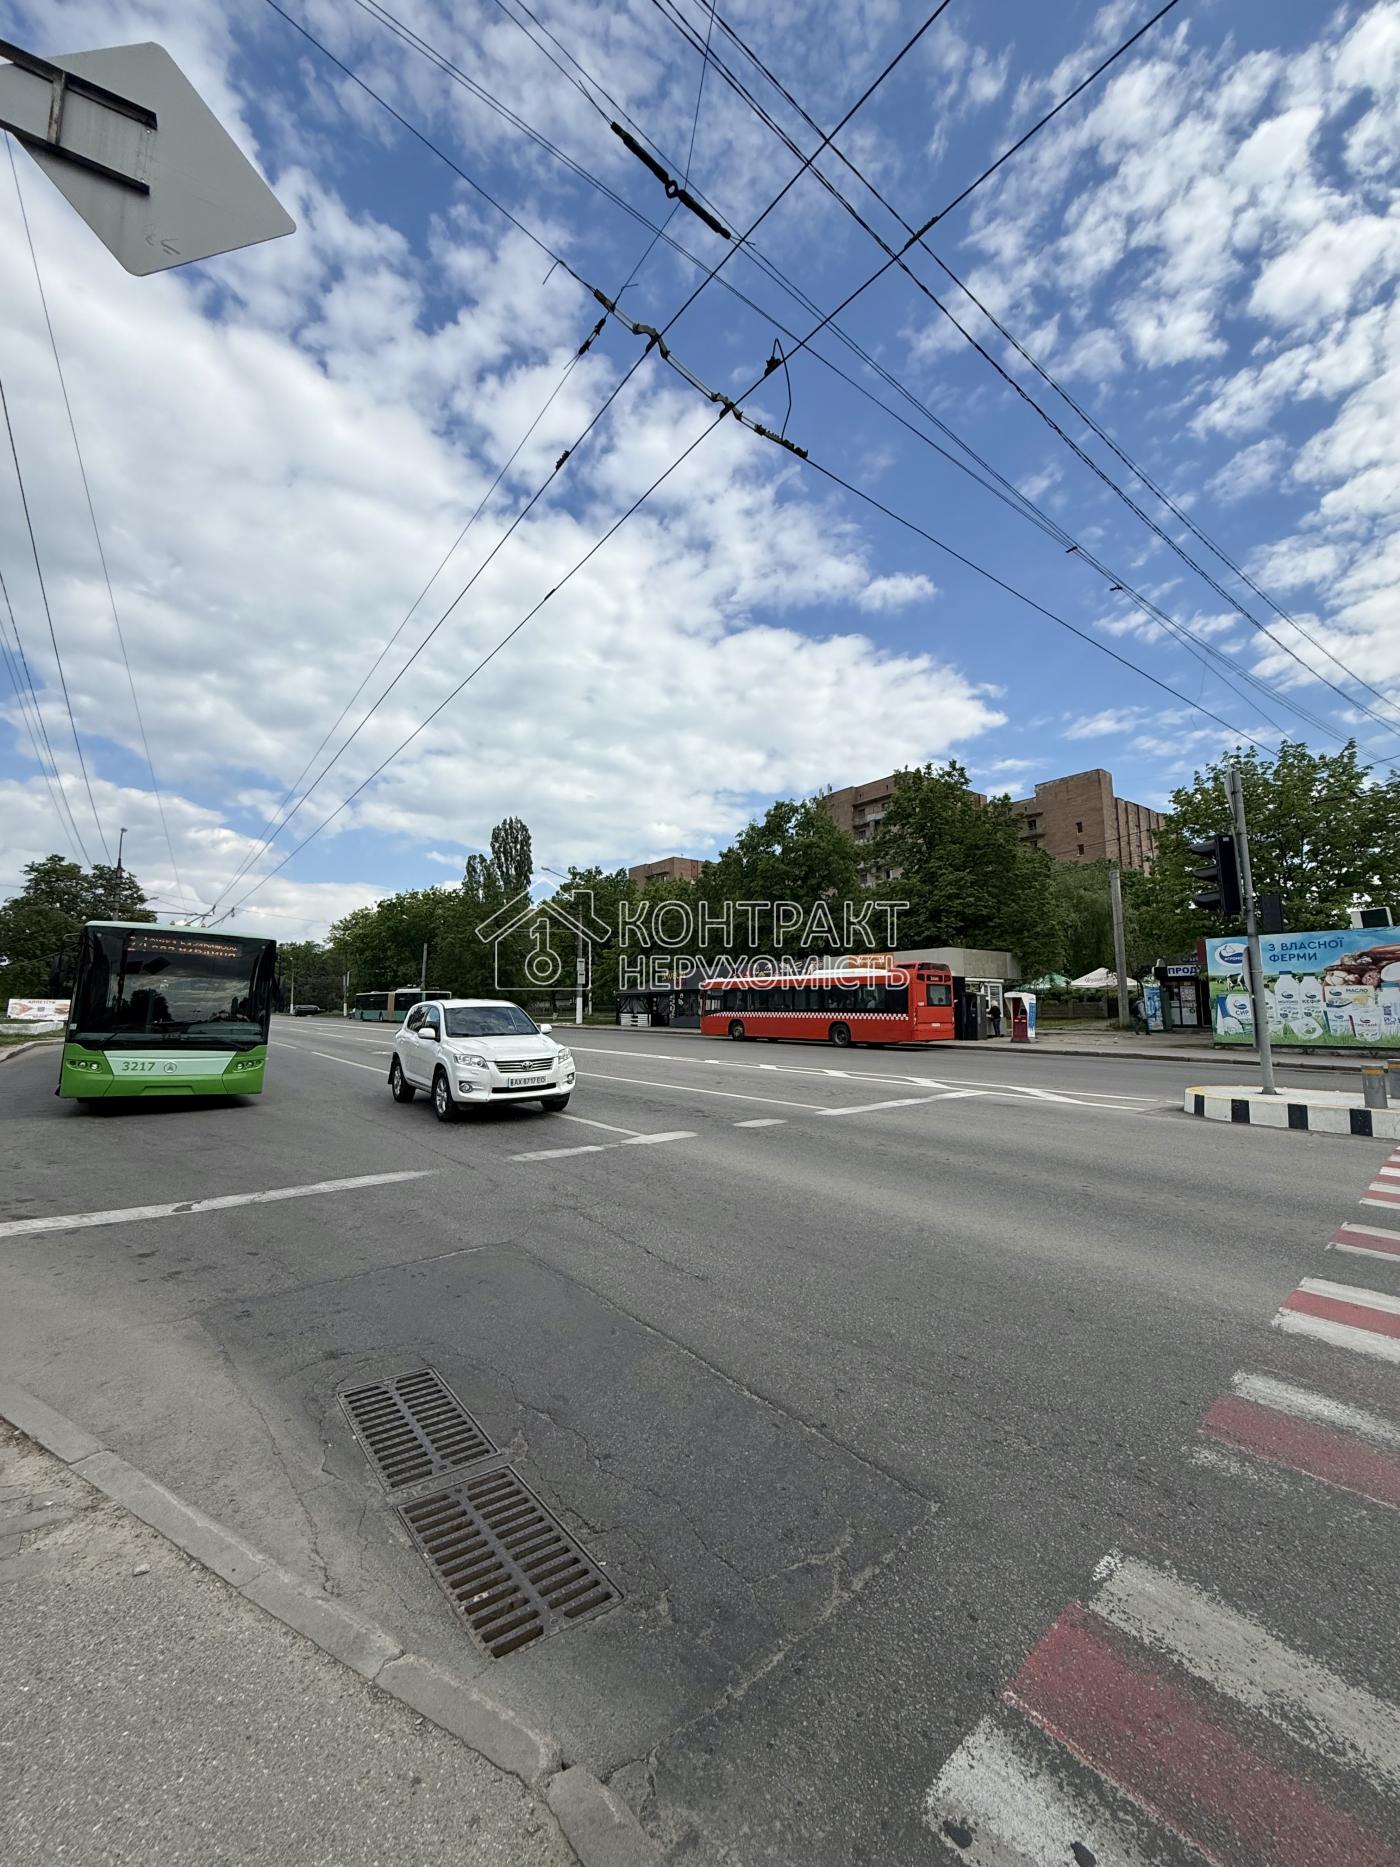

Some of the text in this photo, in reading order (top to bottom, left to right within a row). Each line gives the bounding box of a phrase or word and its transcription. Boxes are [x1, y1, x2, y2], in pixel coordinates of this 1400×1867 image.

[1268, 936, 1344, 952] З ВЛАСНОЇ
[1269, 952, 1317, 963] ФЕРМИ
[121, 1061, 156, 1072] 3217
